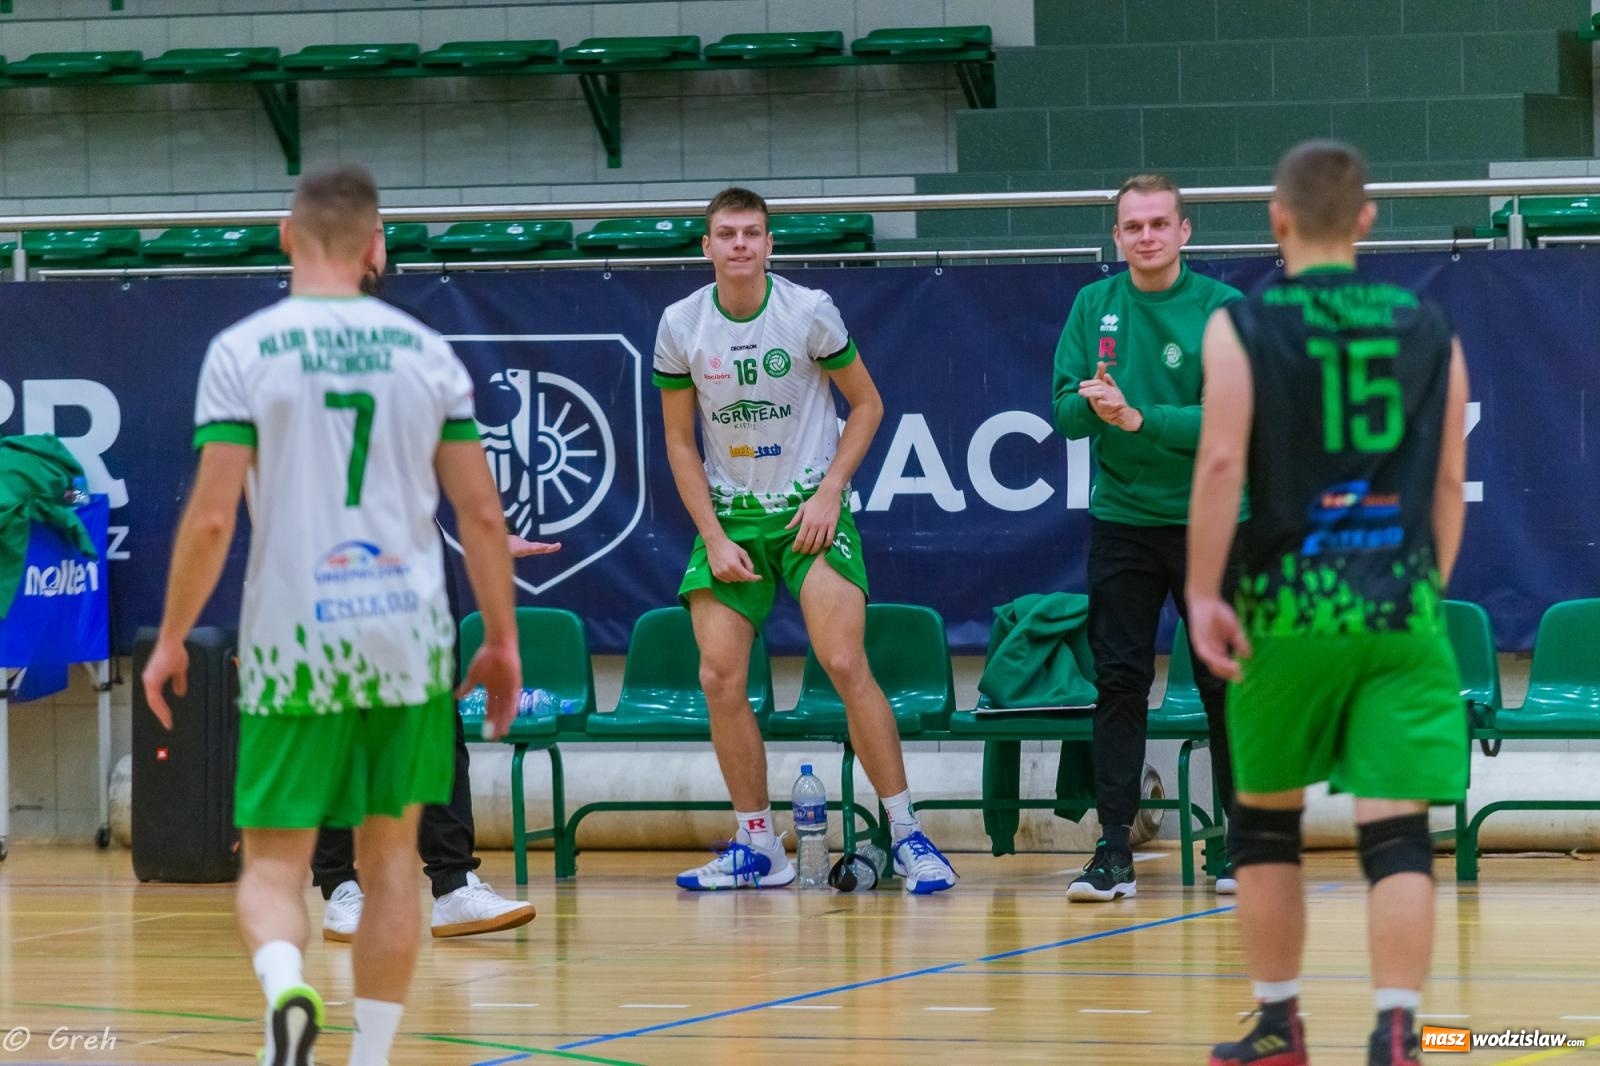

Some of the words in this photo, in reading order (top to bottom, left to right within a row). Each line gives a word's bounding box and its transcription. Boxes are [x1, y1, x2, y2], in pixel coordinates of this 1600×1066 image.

[1098, 336, 1116, 359] R
[733, 358, 758, 386] 16
[1306, 337, 1405, 454] 15
[324, 390, 376, 507] 7
[748, 818, 766, 830] R
